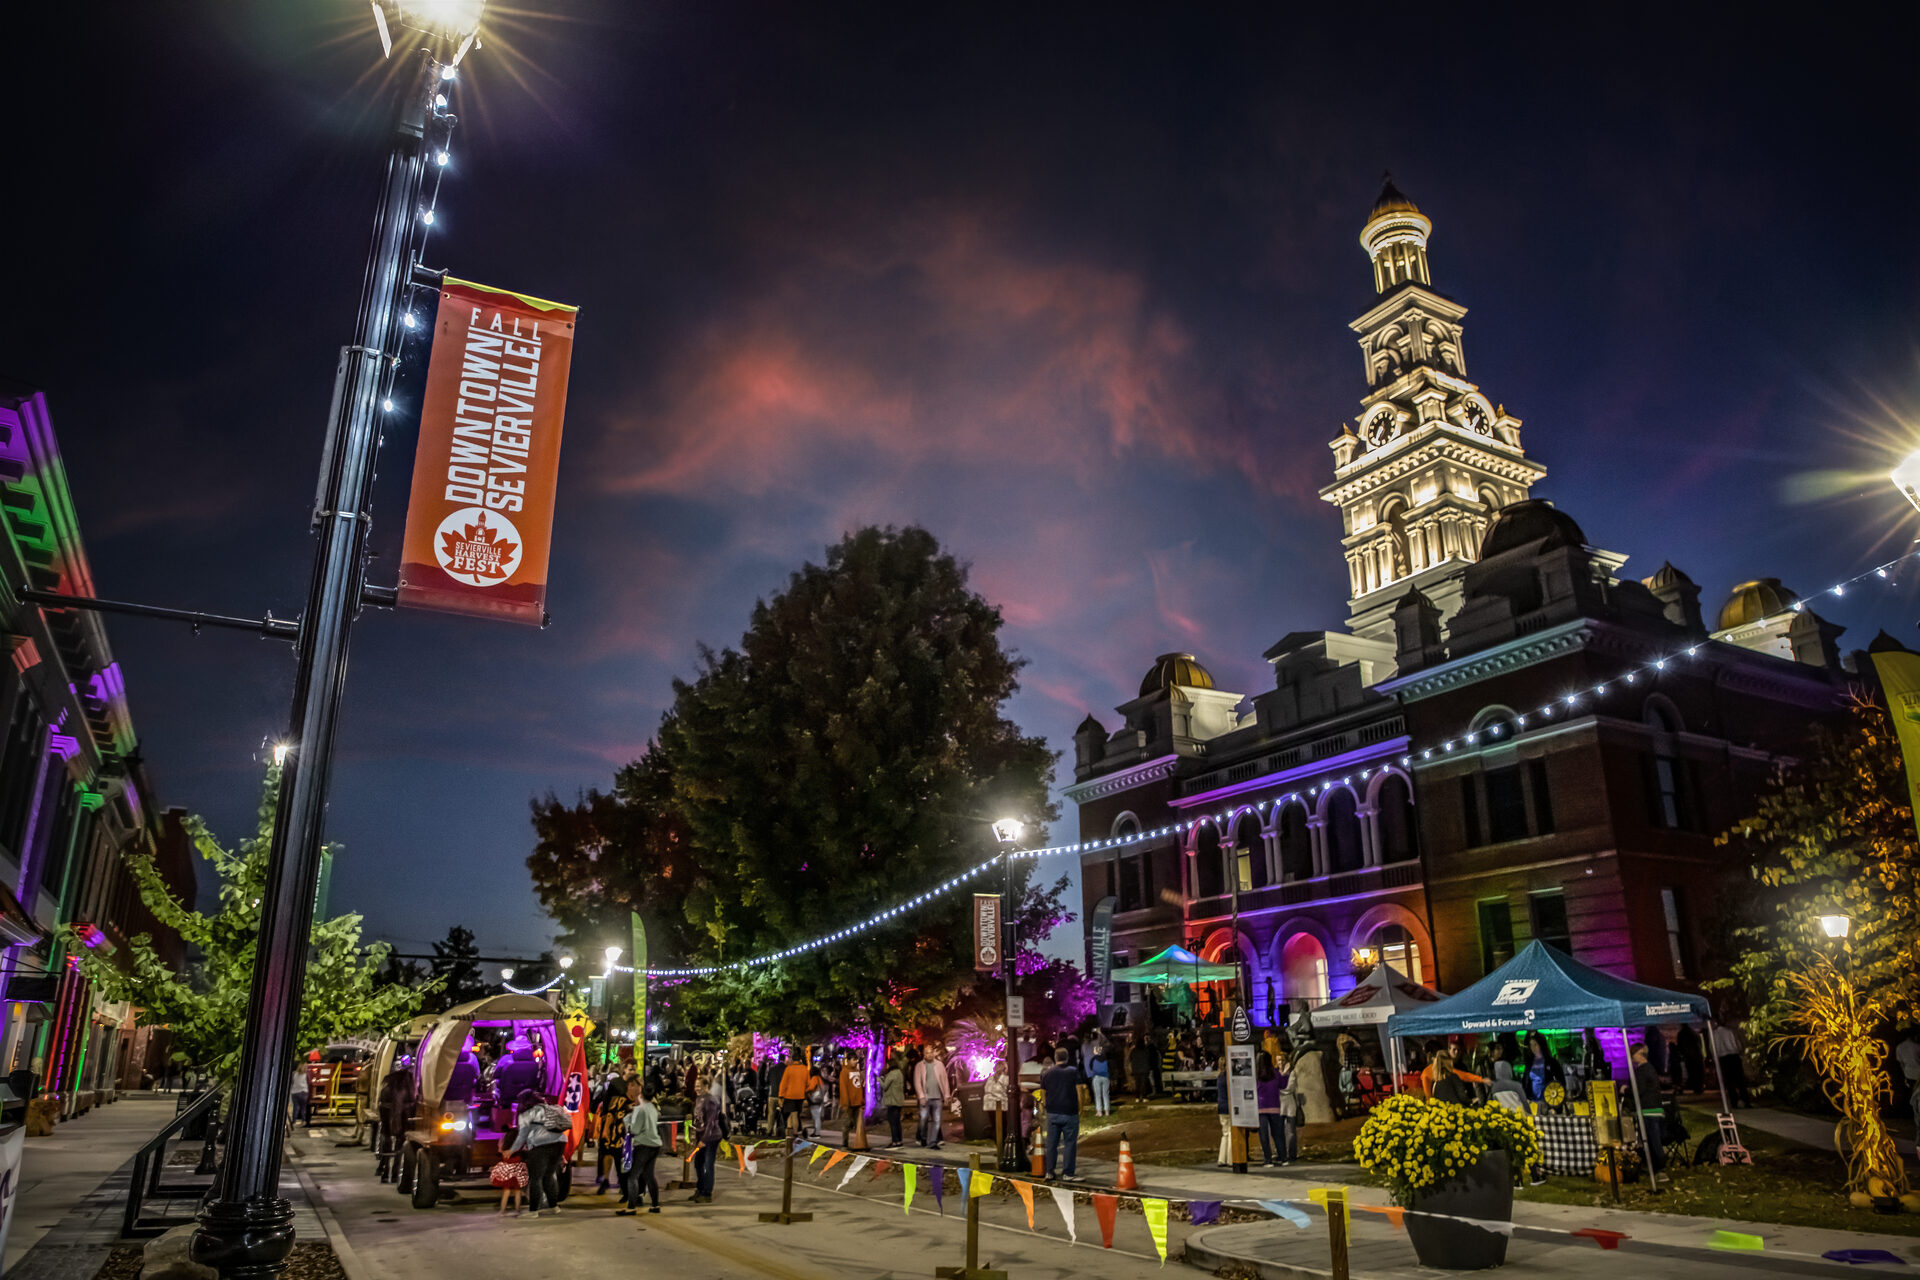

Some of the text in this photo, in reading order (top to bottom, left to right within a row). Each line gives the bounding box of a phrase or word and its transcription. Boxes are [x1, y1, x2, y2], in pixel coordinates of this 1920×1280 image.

[470, 307, 541, 341] FALL
[445, 331, 504, 507] DOWNTOWN
[485, 340, 542, 512] SEVIERVILLE
[455, 541, 502, 556] SEVIERVILLE
[455, 549, 501, 562] HARVEST
[453, 556, 500, 574] FEST
[980, 905, 989, 947] DOWNTOWN
[1462, 1019, 1491, 1030] Upward
[1491, 1019, 1498, 1027] &
